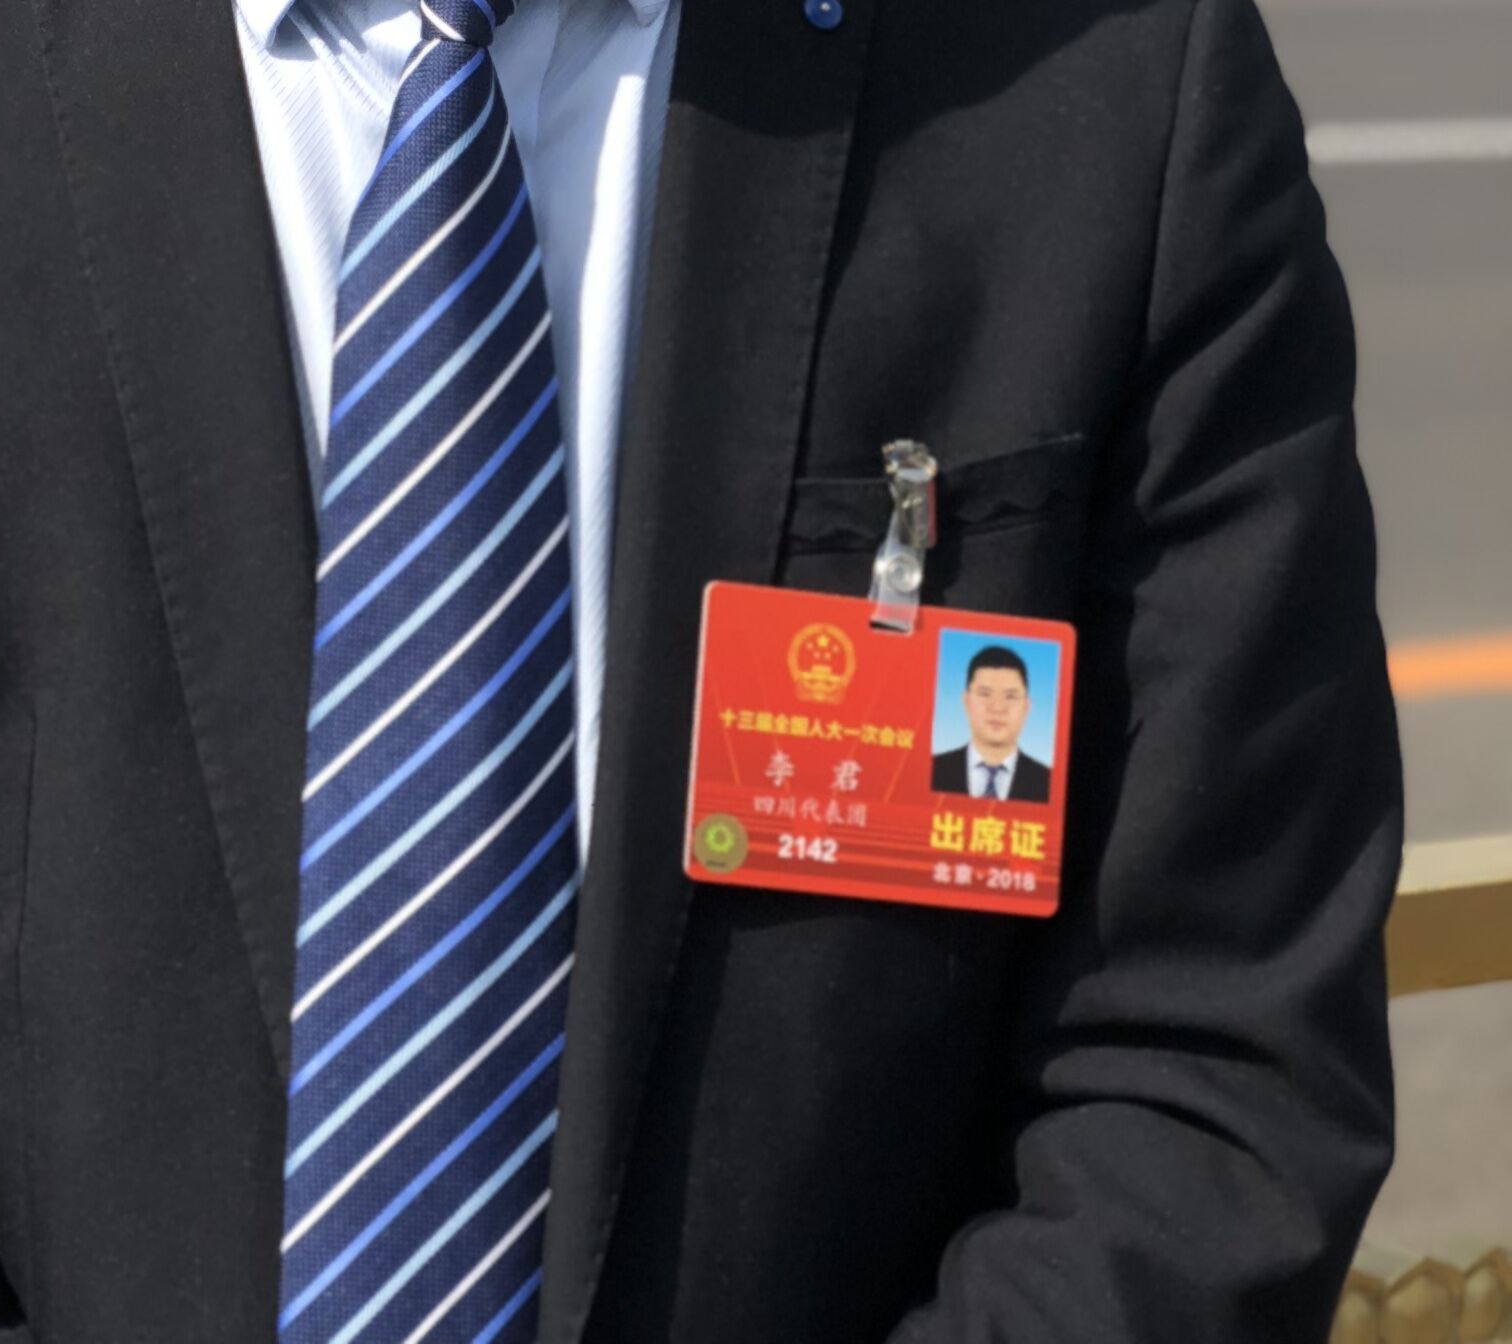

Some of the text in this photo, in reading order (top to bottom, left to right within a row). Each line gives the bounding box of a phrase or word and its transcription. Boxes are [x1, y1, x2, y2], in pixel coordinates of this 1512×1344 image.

[753, 795, 868, 827] 四川代表团
[777, 832, 838, 863] 2142
[929, 811, 1047, 860] 出席证
